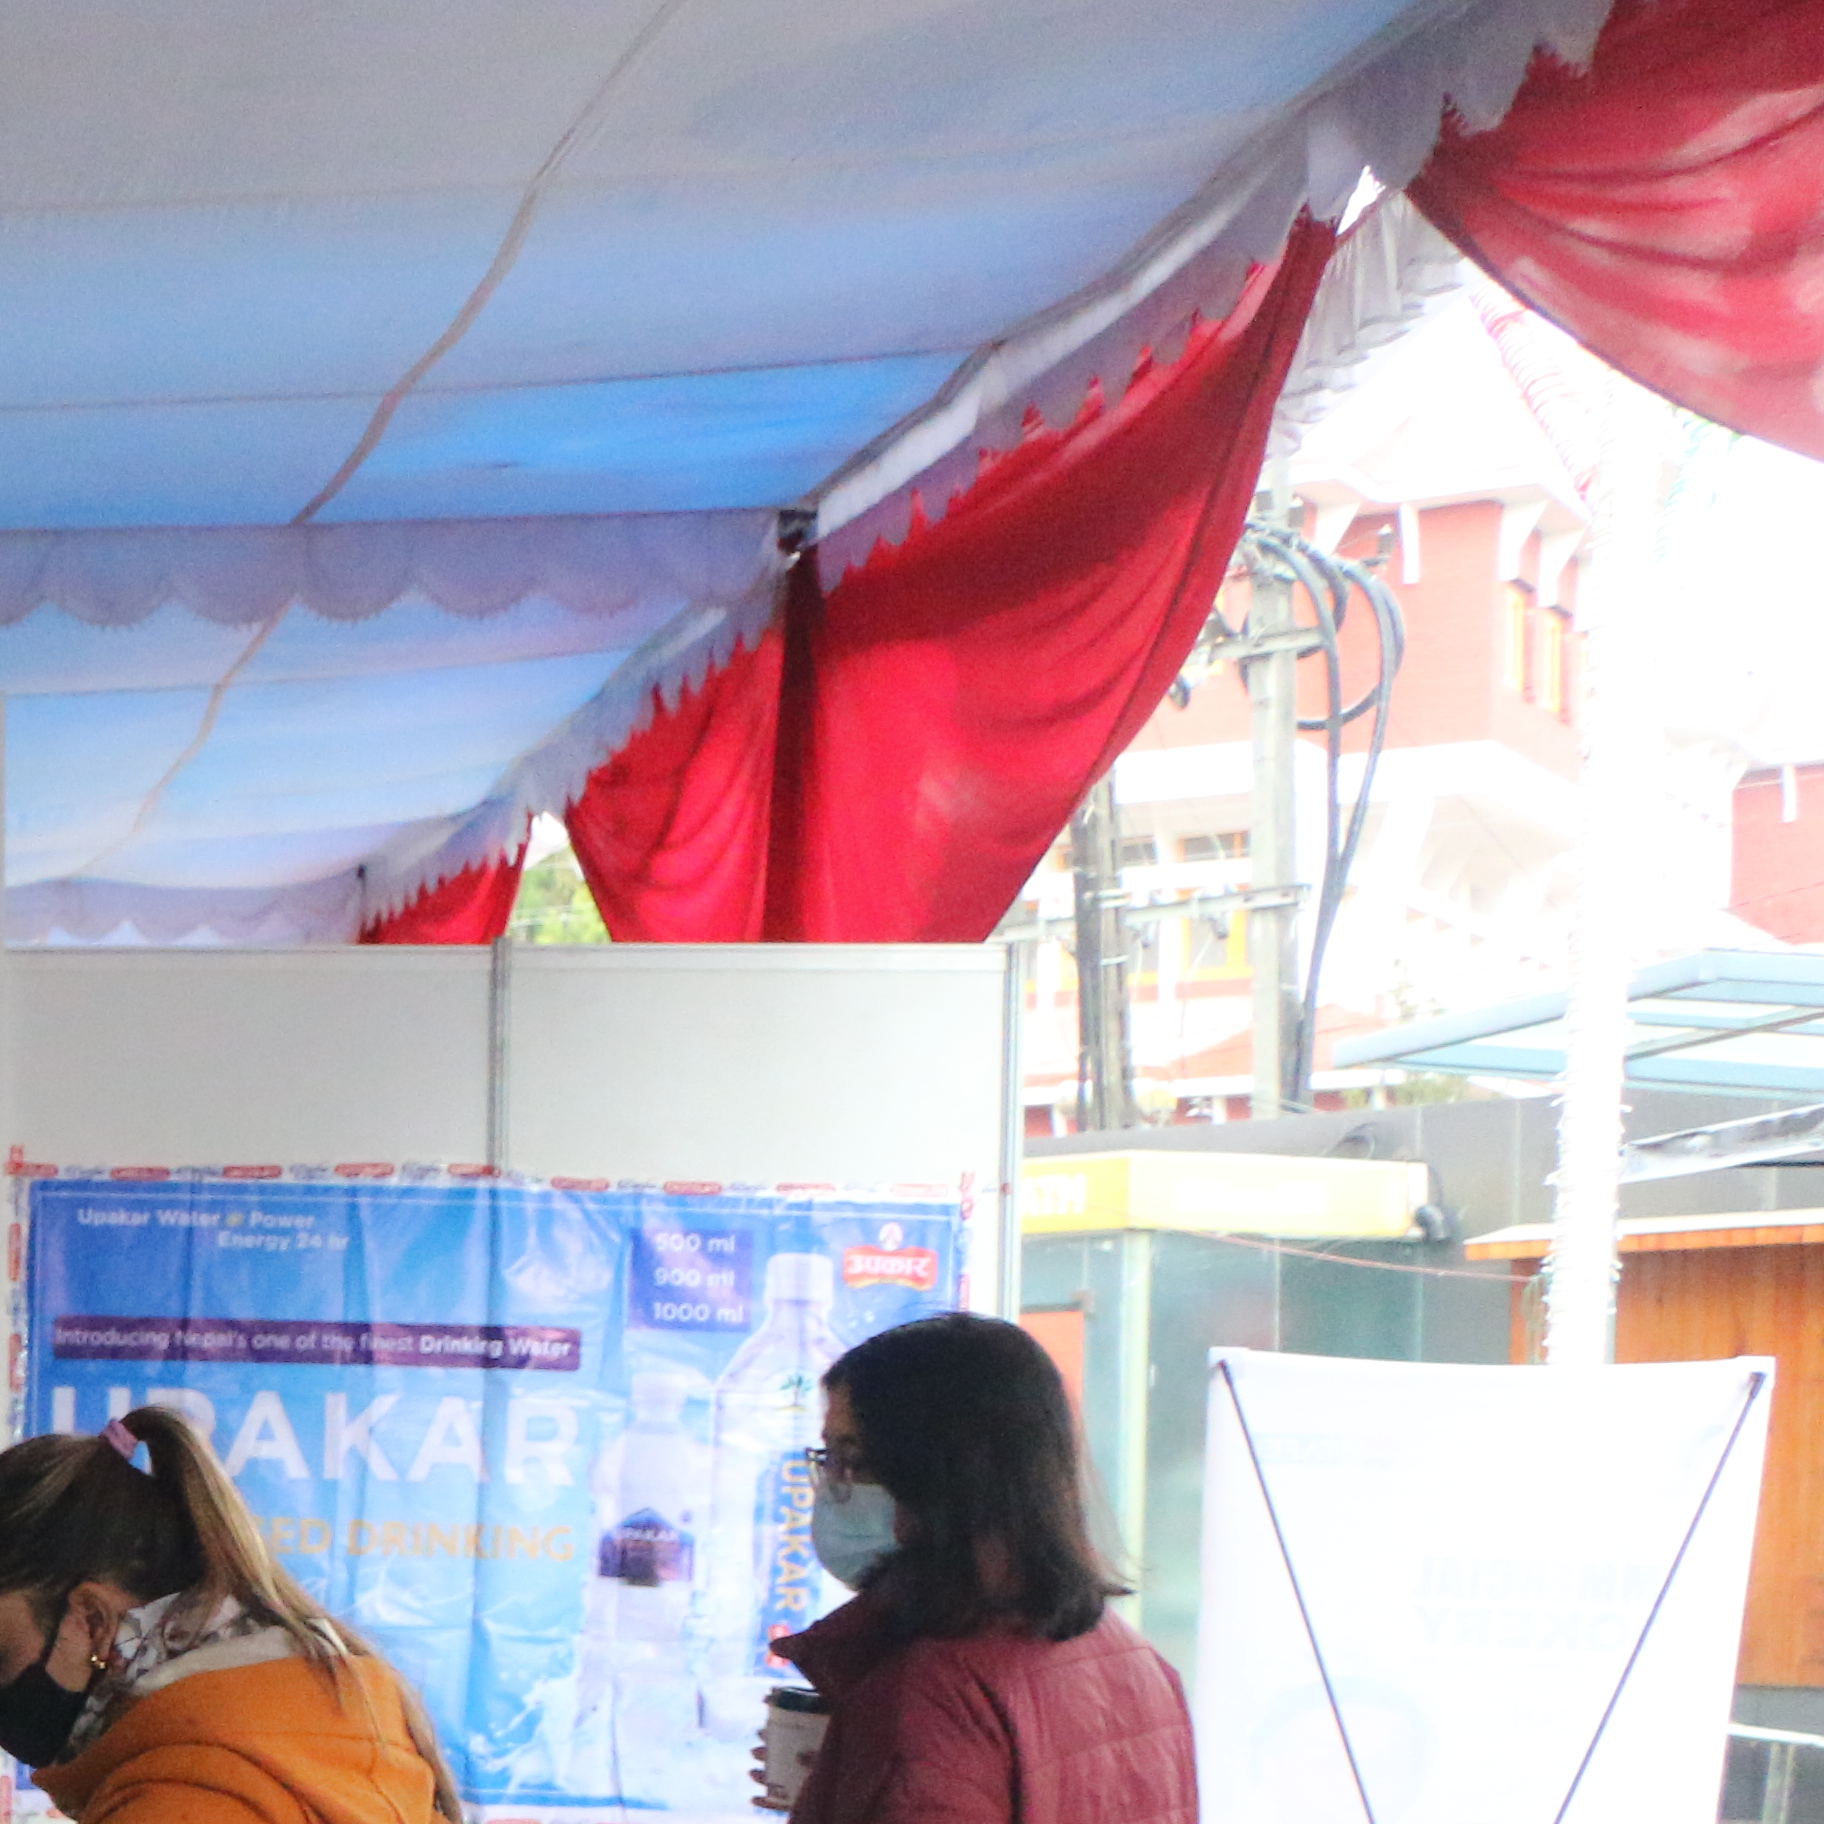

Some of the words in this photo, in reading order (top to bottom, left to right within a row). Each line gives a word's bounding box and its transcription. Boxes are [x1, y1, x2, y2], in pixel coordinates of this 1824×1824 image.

[77, 1209, 150, 1227] Upakar
[157, 1209, 220, 1227] Water
[250, 1211, 315, 1228] Power
[218, 1232, 290, 1251] Energy
[327, 1234, 349, 1250] hr
[656, 1234, 700, 1252] 500
[708, 1235, 735, 1252] ml
[656, 1269, 700, 1287] 900
[706, 1269, 735, 1288] ml
[654, 1303, 710, 1321] 1000
[717, 1304, 743, 1322] ml
[55, 1328, 171, 1351] Introducing
[175, 1330, 247, 1352] Nepal's
[253, 1335, 292, 1350] one
[295, 1332, 316, 1350] of
[321, 1333, 355, 1351] the
[360, 1333, 413, 1351] finest
[420, 1334, 502, 1357] Drinking
[508, 1338, 572, 1356] Water
[346, 1519, 575, 1562] DRINKING
[776, 1460, 815, 1611] UPAKAR
